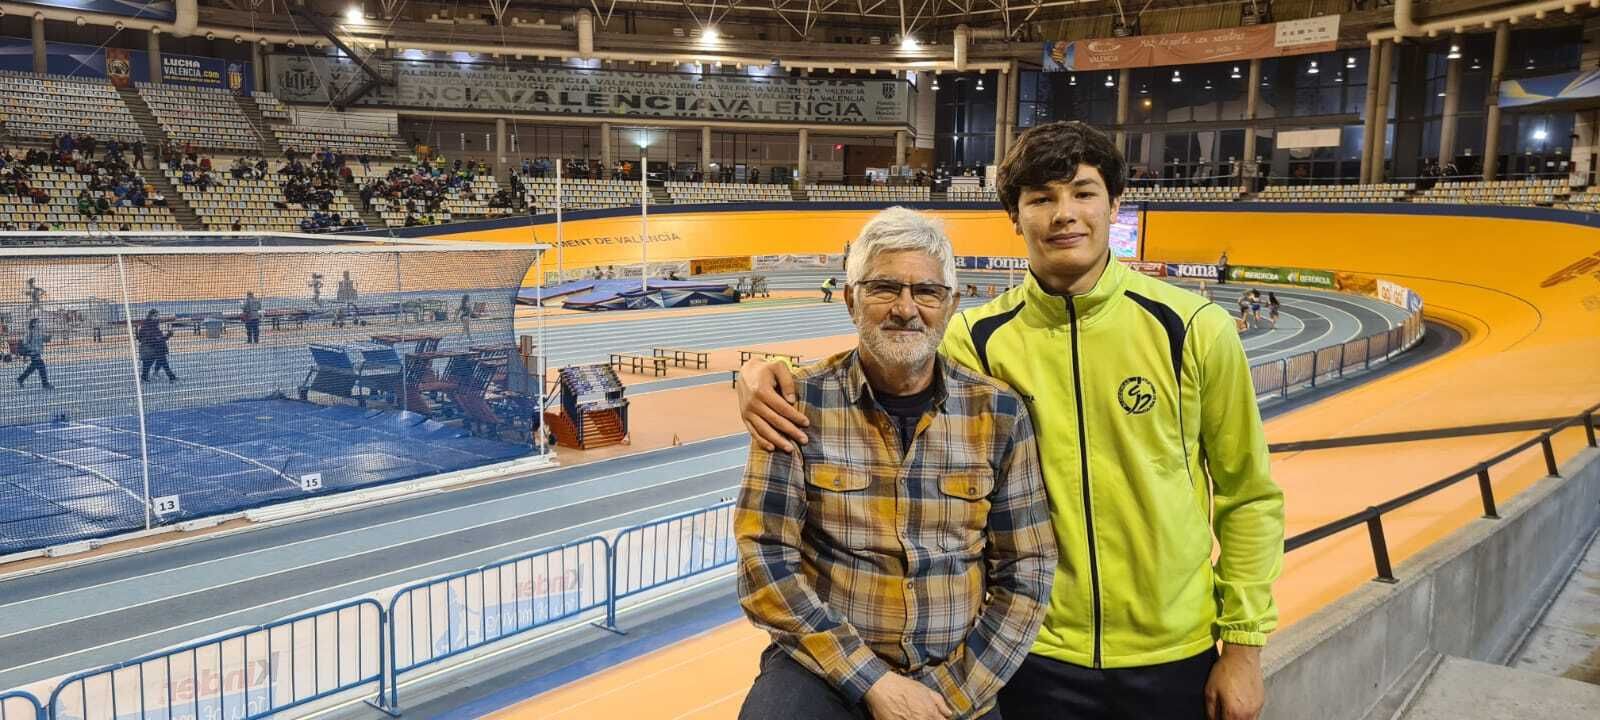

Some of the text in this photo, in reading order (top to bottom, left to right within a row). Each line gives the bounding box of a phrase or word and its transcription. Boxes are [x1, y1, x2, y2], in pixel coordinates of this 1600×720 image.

[163, 57, 200, 68] LUCHA
[398, 69, 461, 78] ALENCIA
[517, 74, 590, 85] VALENCIA
[596, 79, 656, 88] VALENCIA
[660, 81, 713, 90] VALENCIA
[718, 84, 764, 92] VALENCIA
[766, 86, 820, 95] VALENCIA
[564, 85, 631, 94] VALENCIA
[634, 87, 697, 96] VALENCIA
[699, 90, 750, 98] VALENCIA
[754, 92, 816, 101] VALENCIA
[820, 94, 865, 102] VALENCIA
[596, 237, 612, 245] DE
[614, 233, 680, 244] VALENCIA
[306, 478, 318, 488] 15
[159, 500, 175, 511] 13
